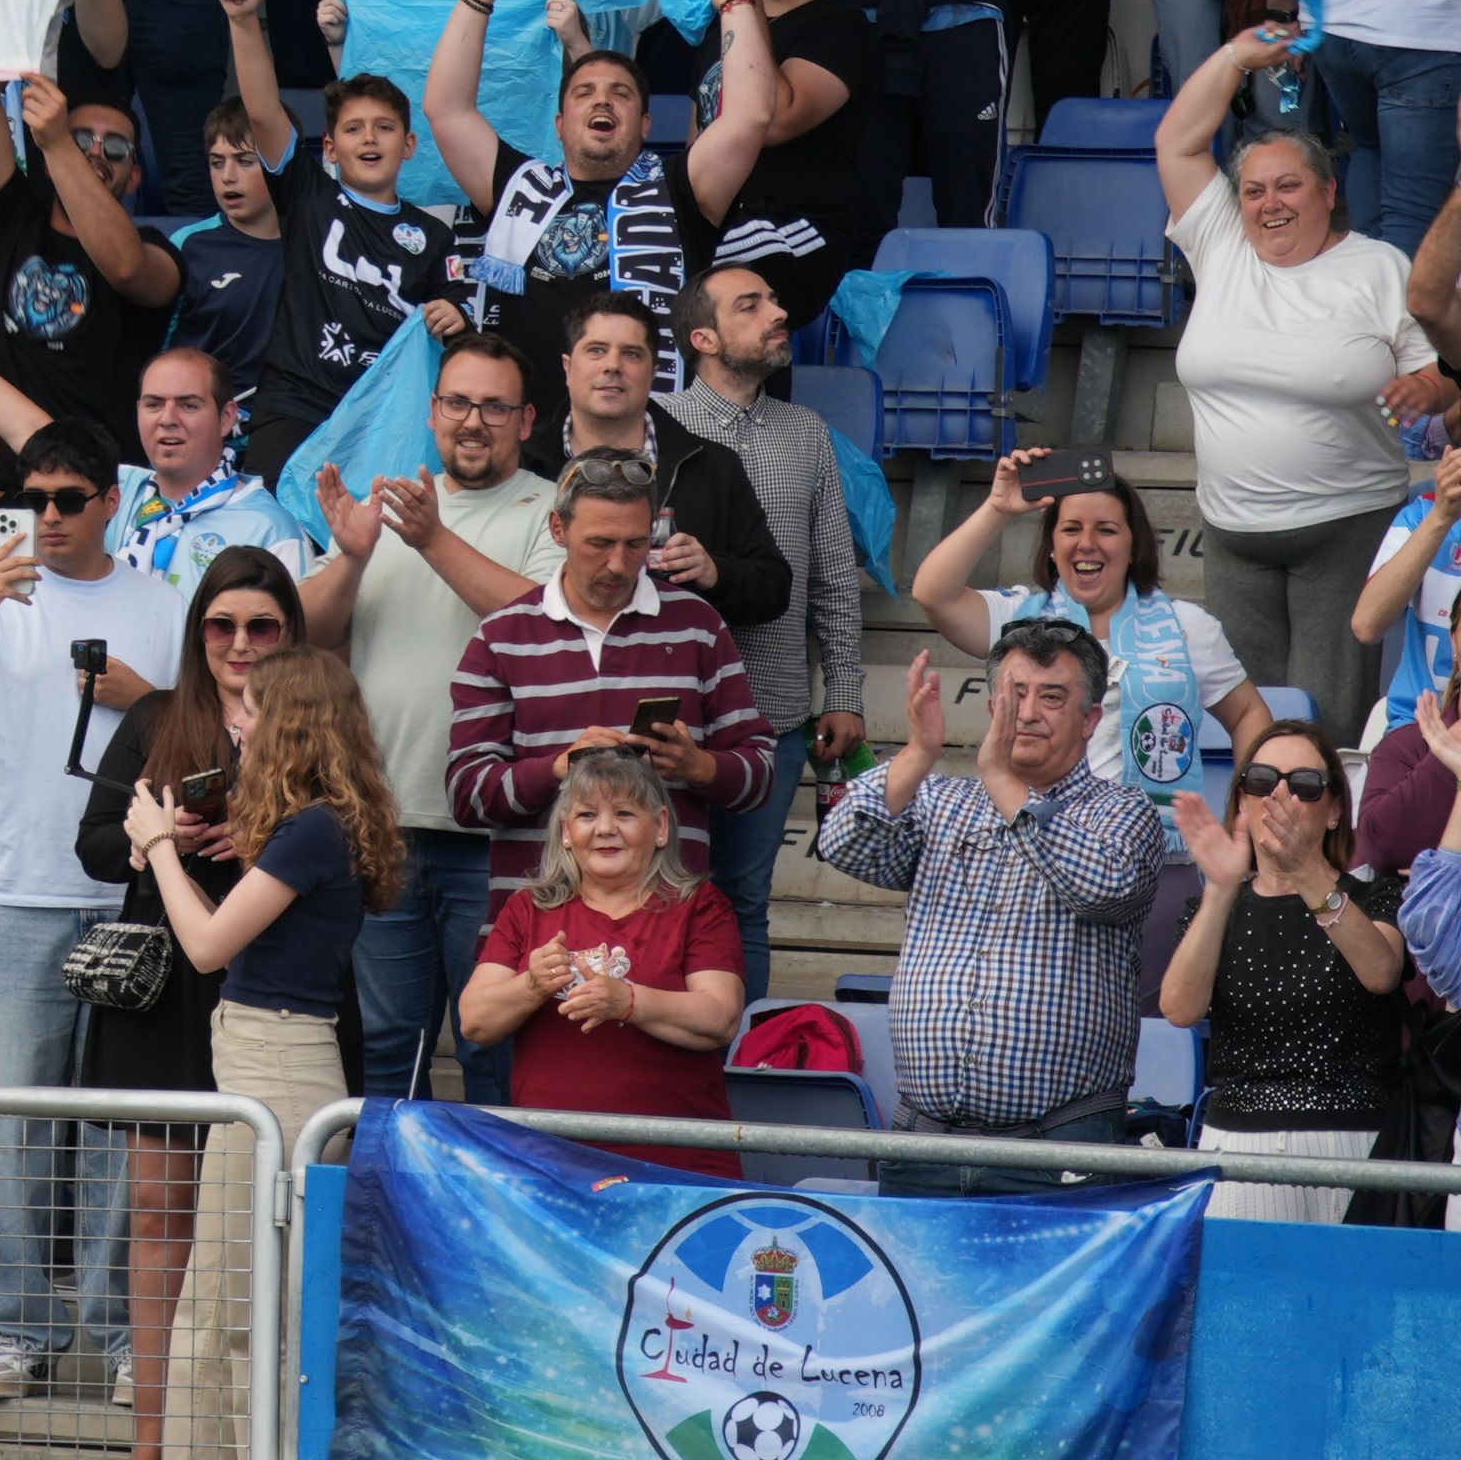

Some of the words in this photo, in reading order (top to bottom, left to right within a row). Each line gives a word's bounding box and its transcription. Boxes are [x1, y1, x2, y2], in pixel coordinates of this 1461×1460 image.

[639, 1306, 738, 1382] Ciudad
[752, 1344, 784, 1378] de
[800, 1344, 905, 1391] Lucena
[851, 1401, 886, 1420] 2008
